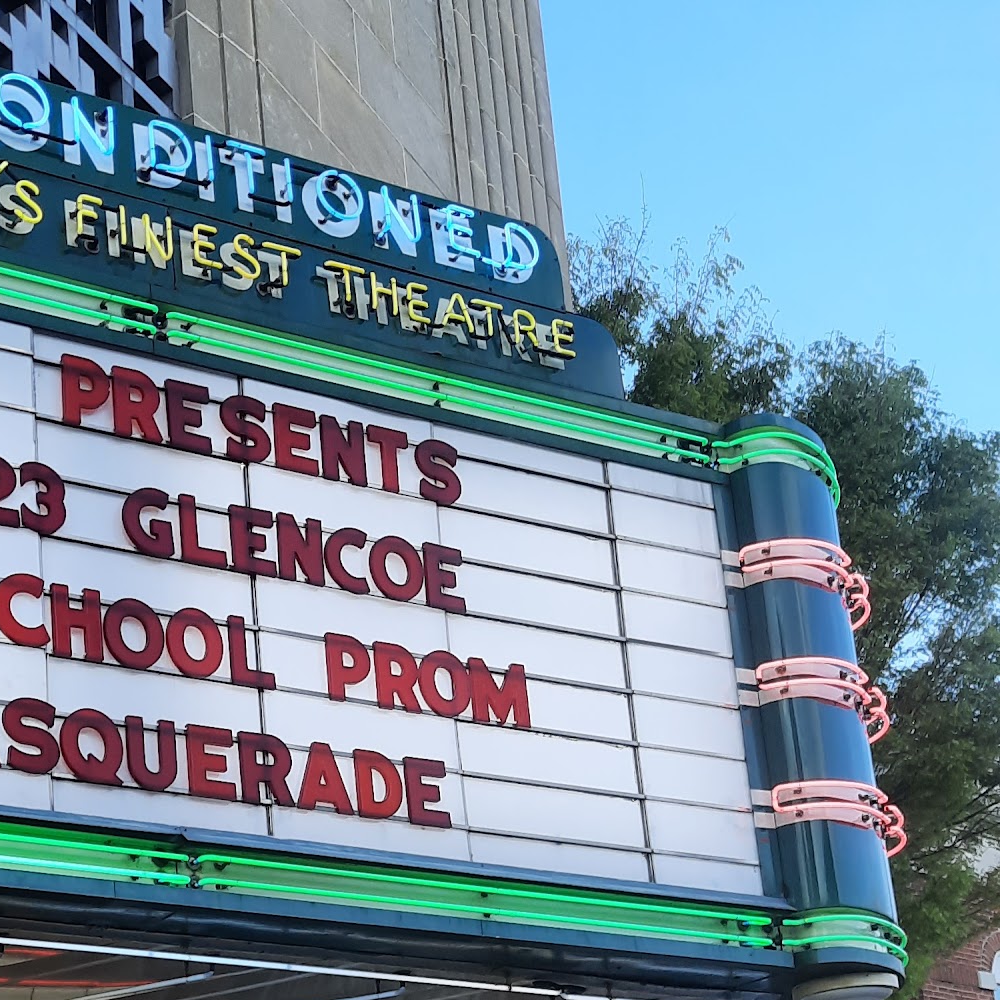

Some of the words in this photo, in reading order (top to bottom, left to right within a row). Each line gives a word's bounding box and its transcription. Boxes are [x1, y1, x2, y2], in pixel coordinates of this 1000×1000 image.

[64, 193, 302, 300] FINEST
[317, 259, 577, 371] THEATRE
[60, 353, 463, 506] PRESENTS
[121, 486, 468, 615] GLENCOE
[324, 631, 533, 730] PROM
